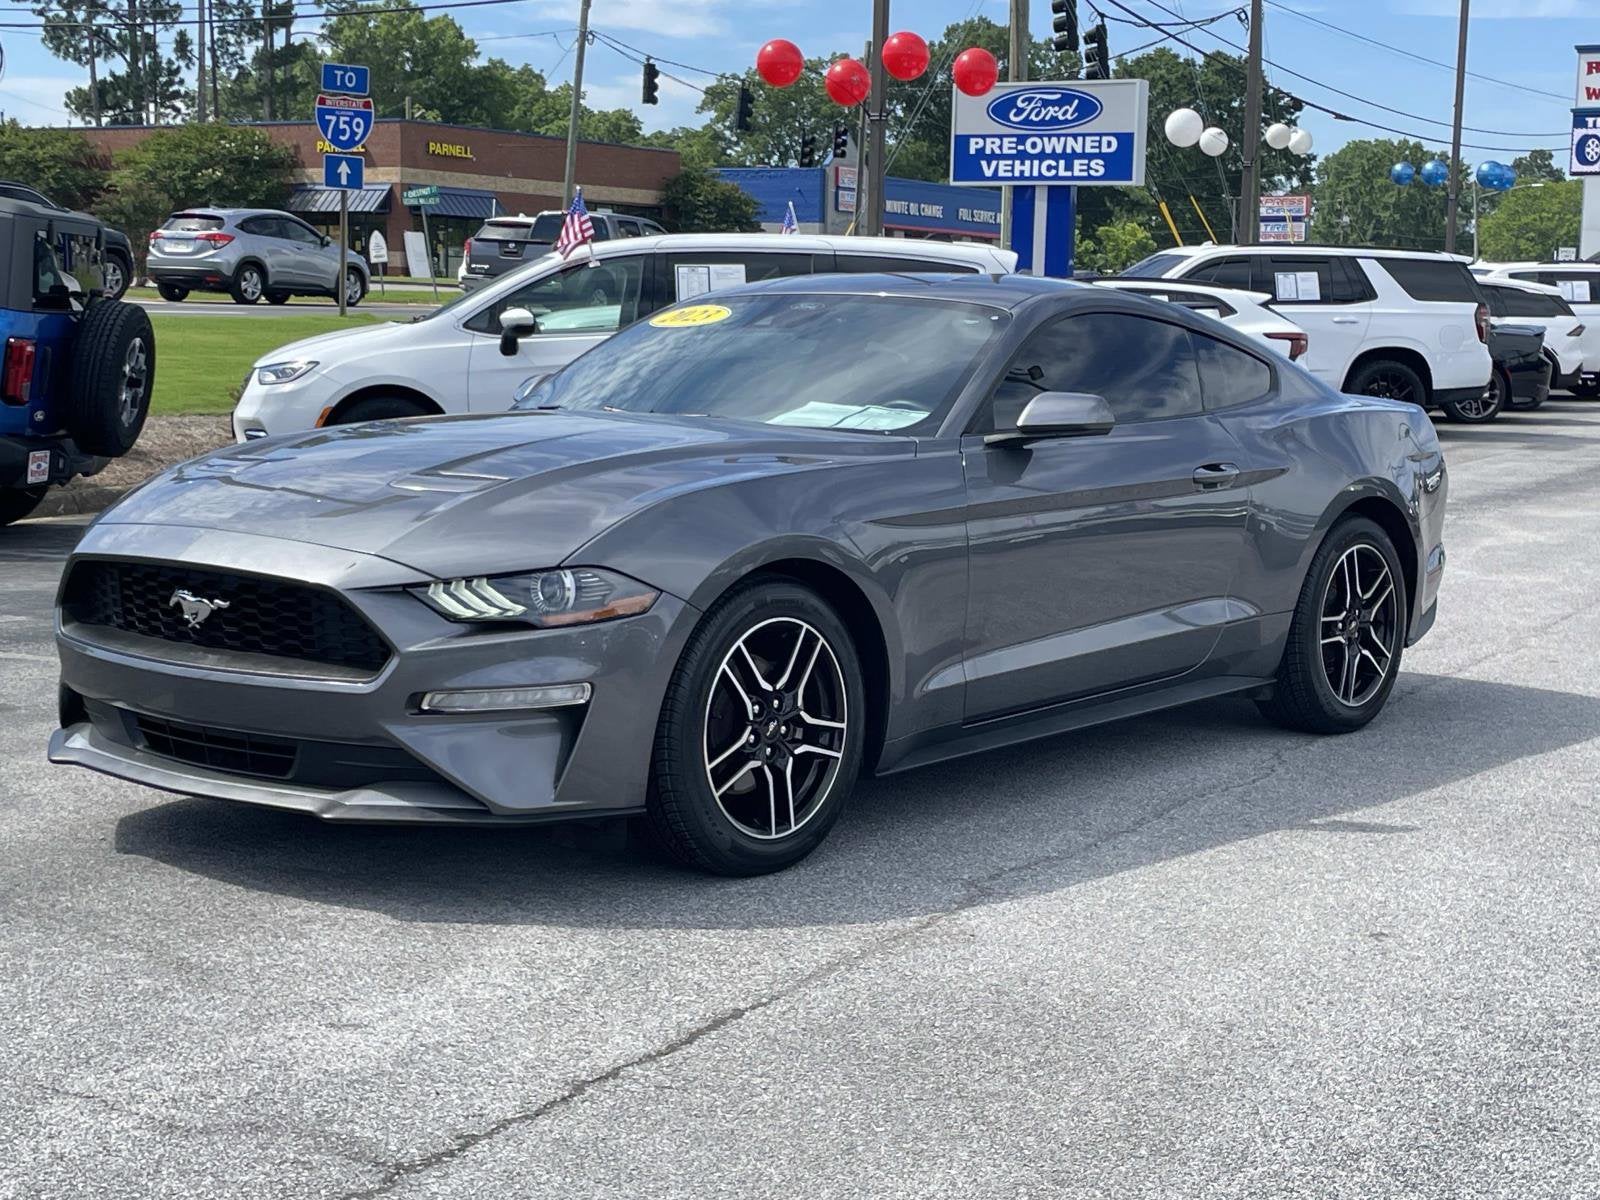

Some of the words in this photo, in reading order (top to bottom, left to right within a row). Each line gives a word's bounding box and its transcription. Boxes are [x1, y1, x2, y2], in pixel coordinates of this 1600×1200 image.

[334, 70, 356, 88] TO
[1009, 93, 1079, 122] Ford
[325, 115, 365, 142] 759
[428, 141, 474, 158] PARNELL
[969, 136, 1118, 154] PRE-OWNED
[980, 159, 1105, 177] VEHICLES
[886, 200, 908, 214] MINUTE
[910, 202, 919, 216] OIL
[920, 203, 944, 219] CHANGE
[958, 208, 972, 221] FULL
[973, 209, 996, 224] SERVICE
